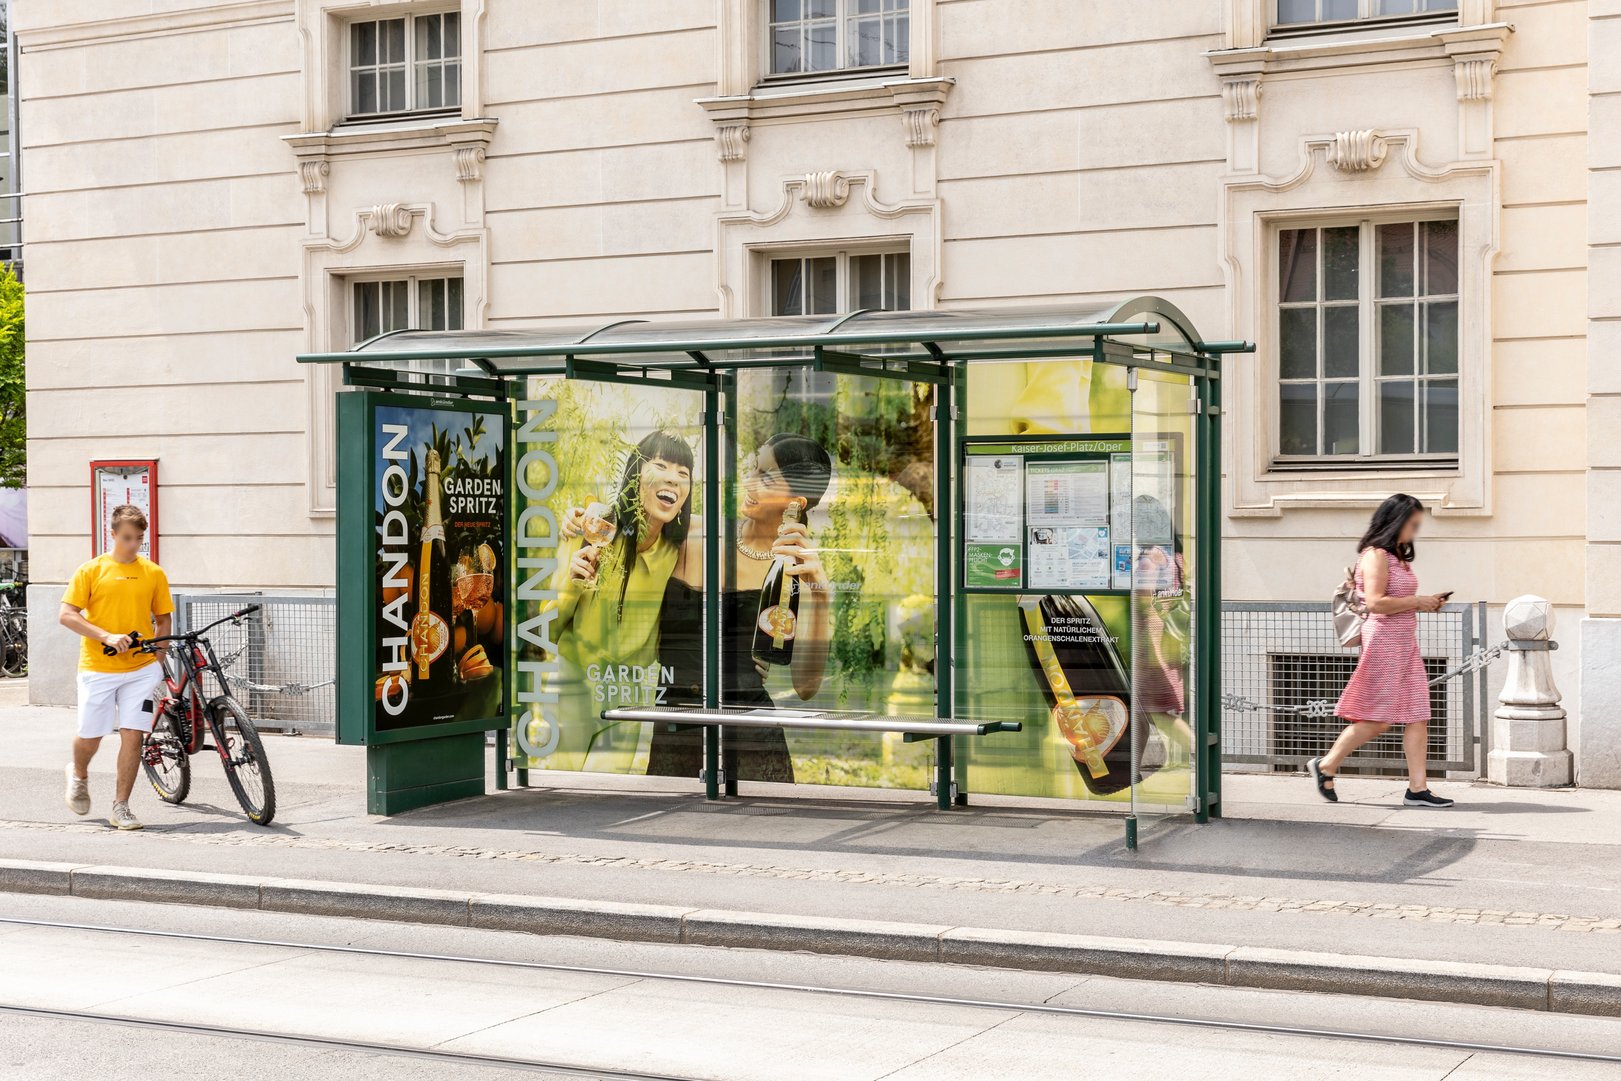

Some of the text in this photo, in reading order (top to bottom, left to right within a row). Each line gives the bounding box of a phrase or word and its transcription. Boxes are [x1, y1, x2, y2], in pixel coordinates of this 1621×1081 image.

[1011, 441, 1123, 454] Kaiser-Josef-Platz/Oper
[444, 478, 501, 496] GARDEN
[449, 496, 497, 514] SPRITZ
[381, 423, 410, 717] CHANDON
[516, 400, 560, 758] CHANDON
[418, 572, 430, 673] CHANDON
[1053, 625, 1102, 634] NATÜRLICHEM
[1066, 617, 1091, 625] SPRITZ
[1023, 635, 1120, 643] ORANGENSCHALENEXTRAKT
[586, 663, 675, 685] GARDEN
[594, 685, 669, 705] SPRITZ
